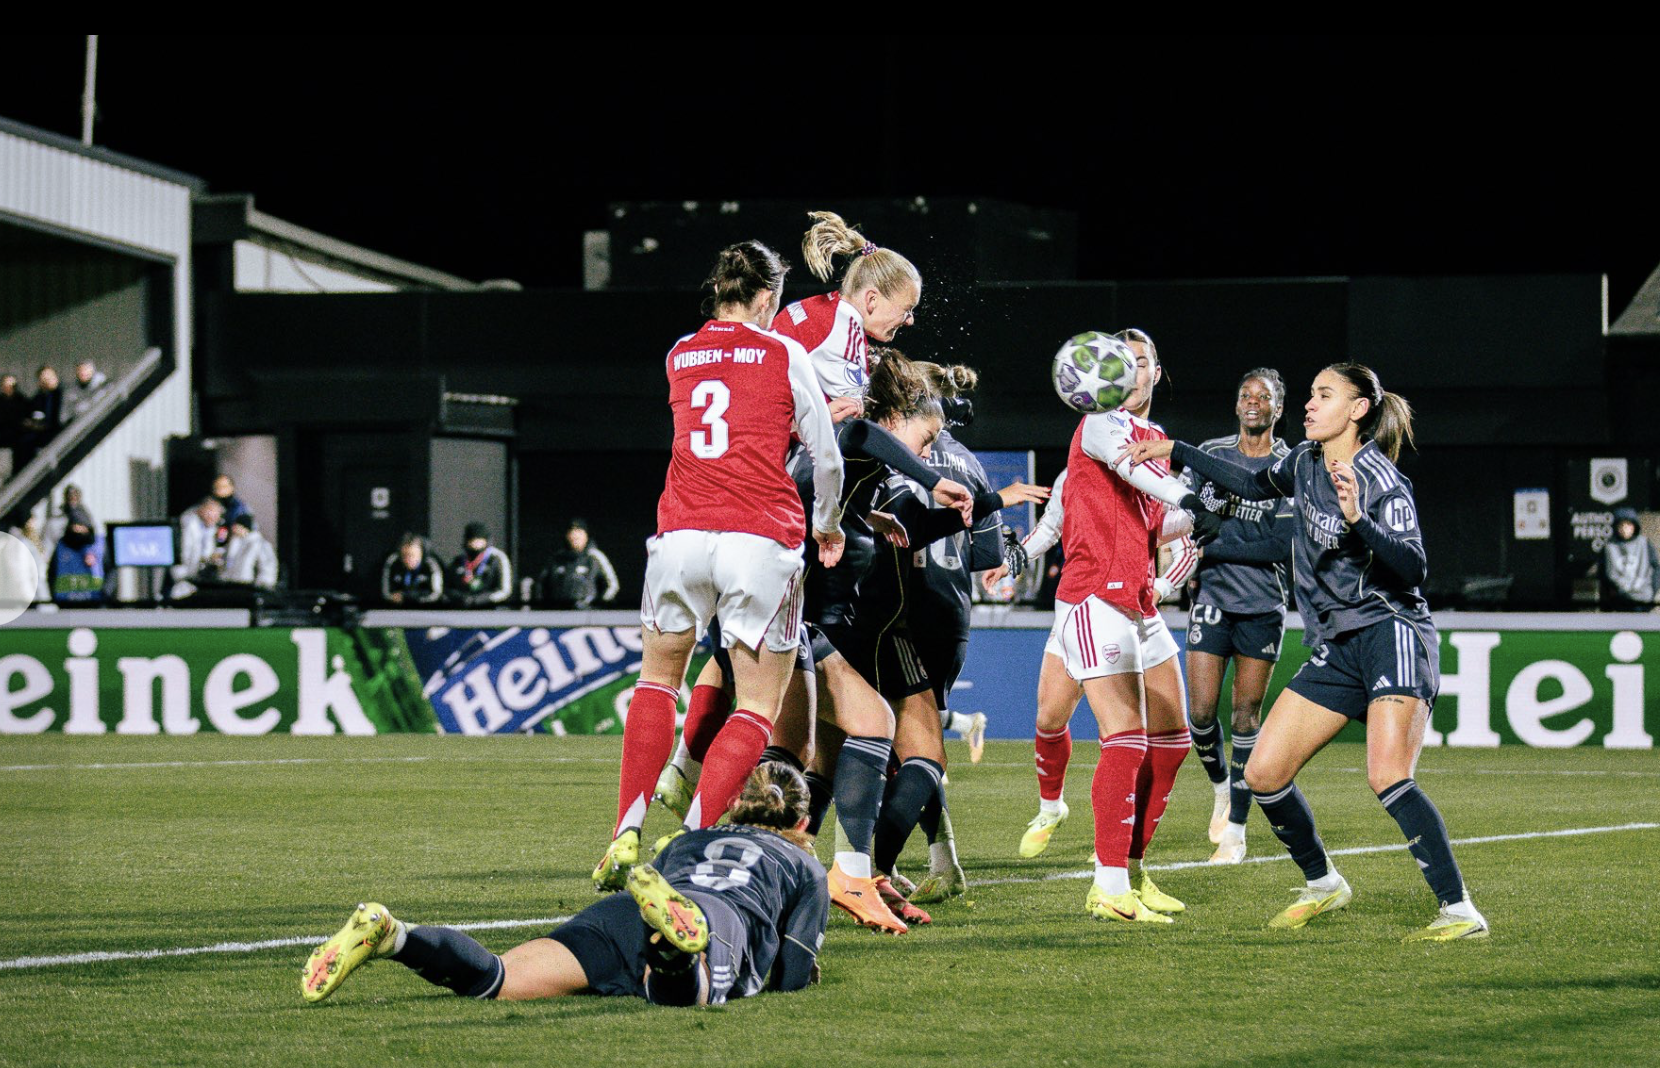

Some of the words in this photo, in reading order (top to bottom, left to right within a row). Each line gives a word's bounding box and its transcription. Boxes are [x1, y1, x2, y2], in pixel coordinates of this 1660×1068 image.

[673, 347, 767, 372] WUBBEN-MOY
[690, 380, 730, 459] 3
[1229, 503, 1263, 523] BETTER
[1390, 499, 1413, 532] hp
